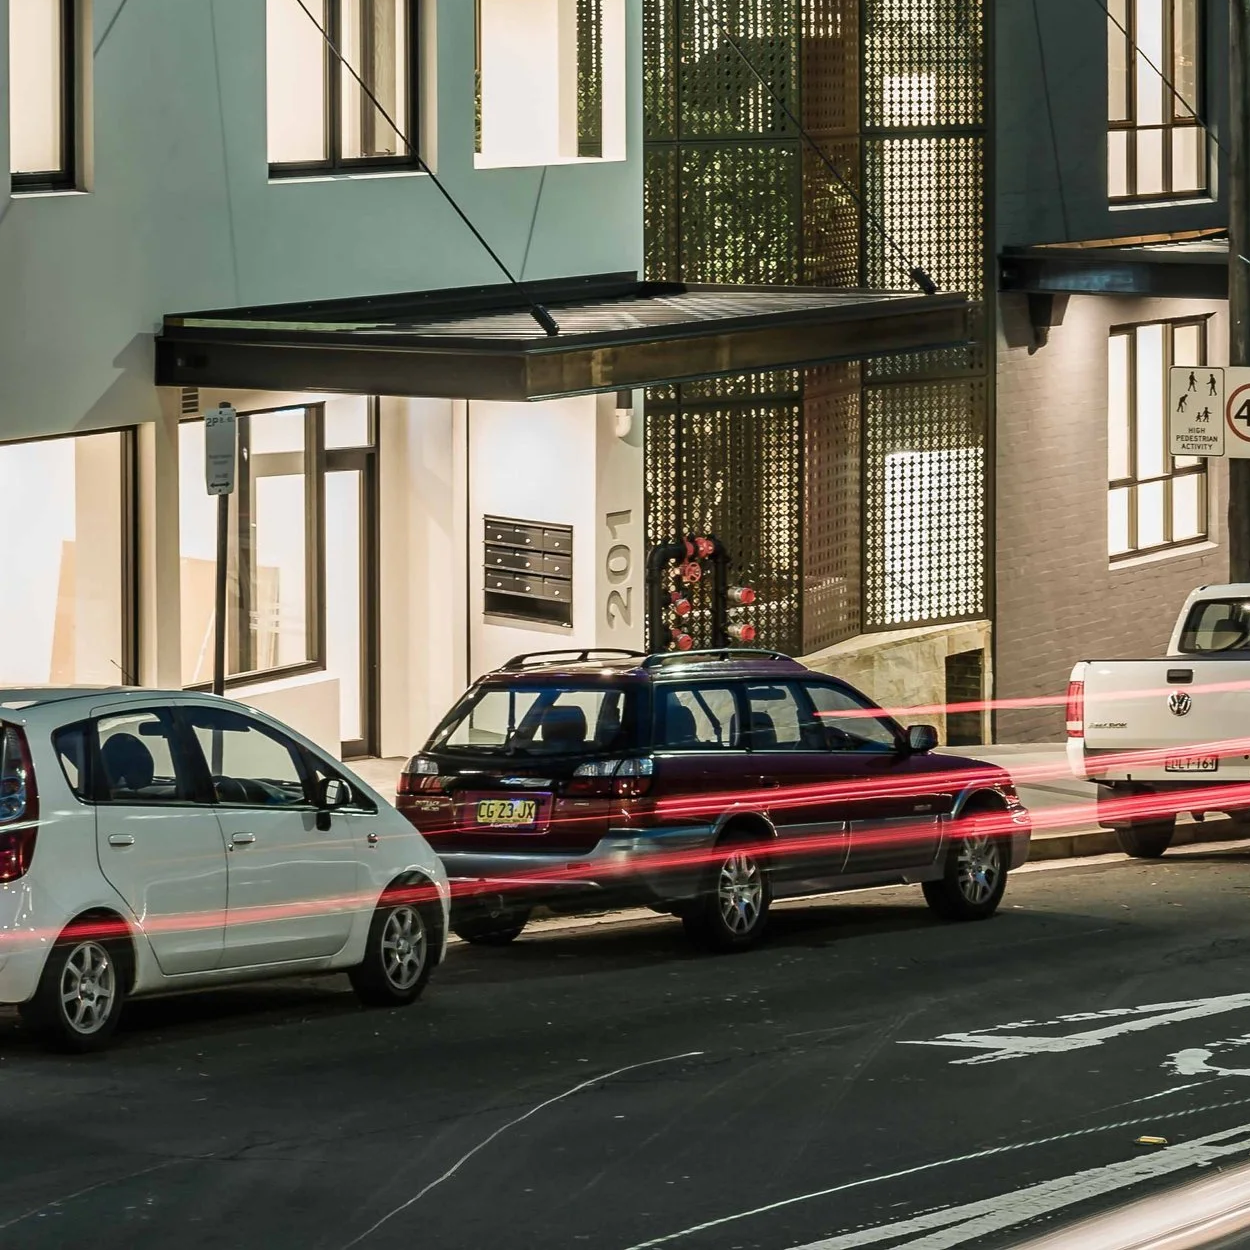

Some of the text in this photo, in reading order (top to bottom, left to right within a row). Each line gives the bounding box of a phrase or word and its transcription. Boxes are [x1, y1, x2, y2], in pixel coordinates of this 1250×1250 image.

[1175, 434, 1218, 442] PEDESTRIAN
[605, 509, 633, 630] 201
[497, 802, 515, 818] 23
